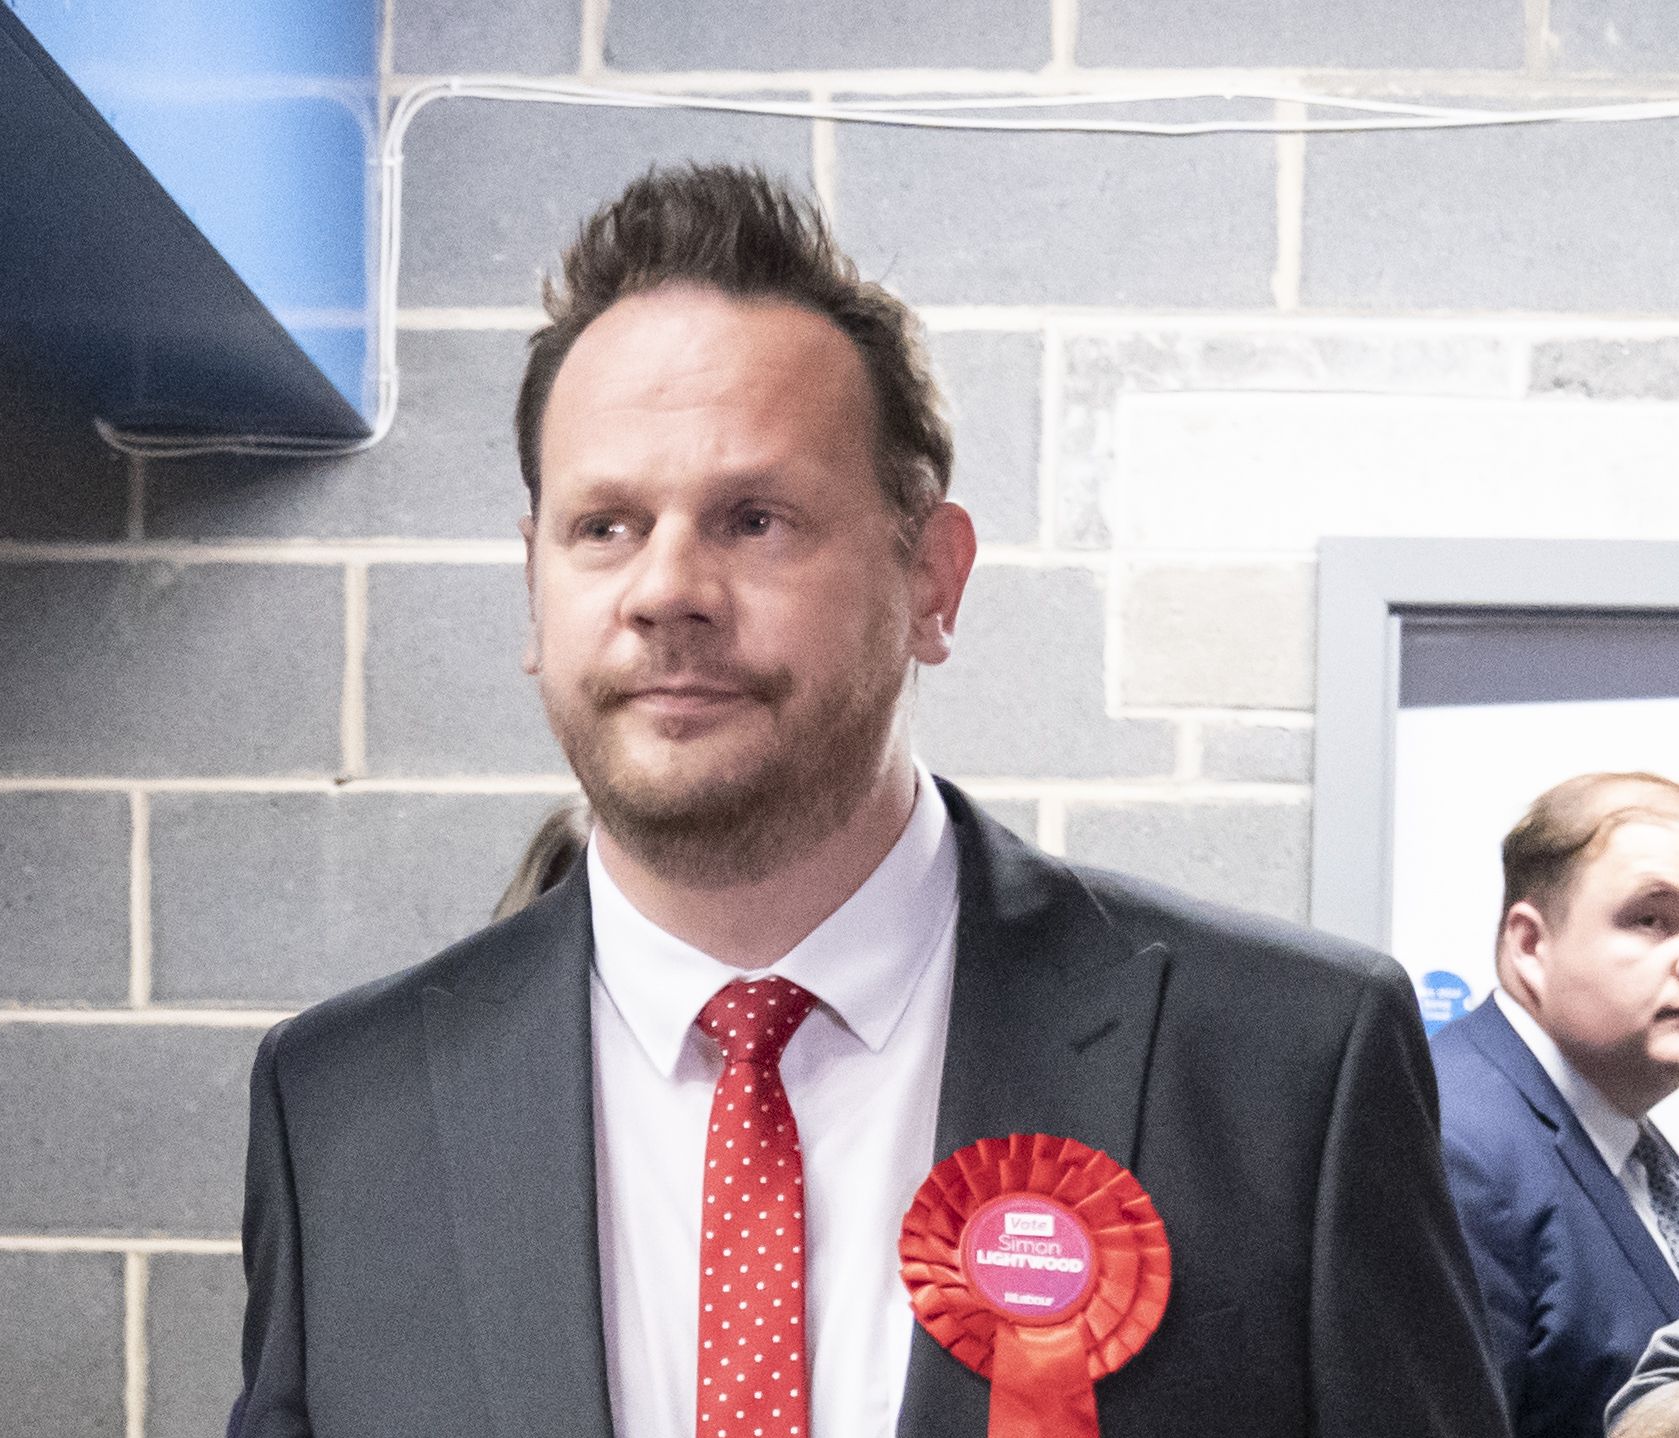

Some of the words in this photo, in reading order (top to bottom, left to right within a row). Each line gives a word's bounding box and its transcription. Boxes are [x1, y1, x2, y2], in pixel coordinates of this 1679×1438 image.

[1011, 1217, 1048, 1231] Vote
[998, 1234, 1061, 1256] Simon
[976, 1249, 1084, 1273] LIGHTWOOD
